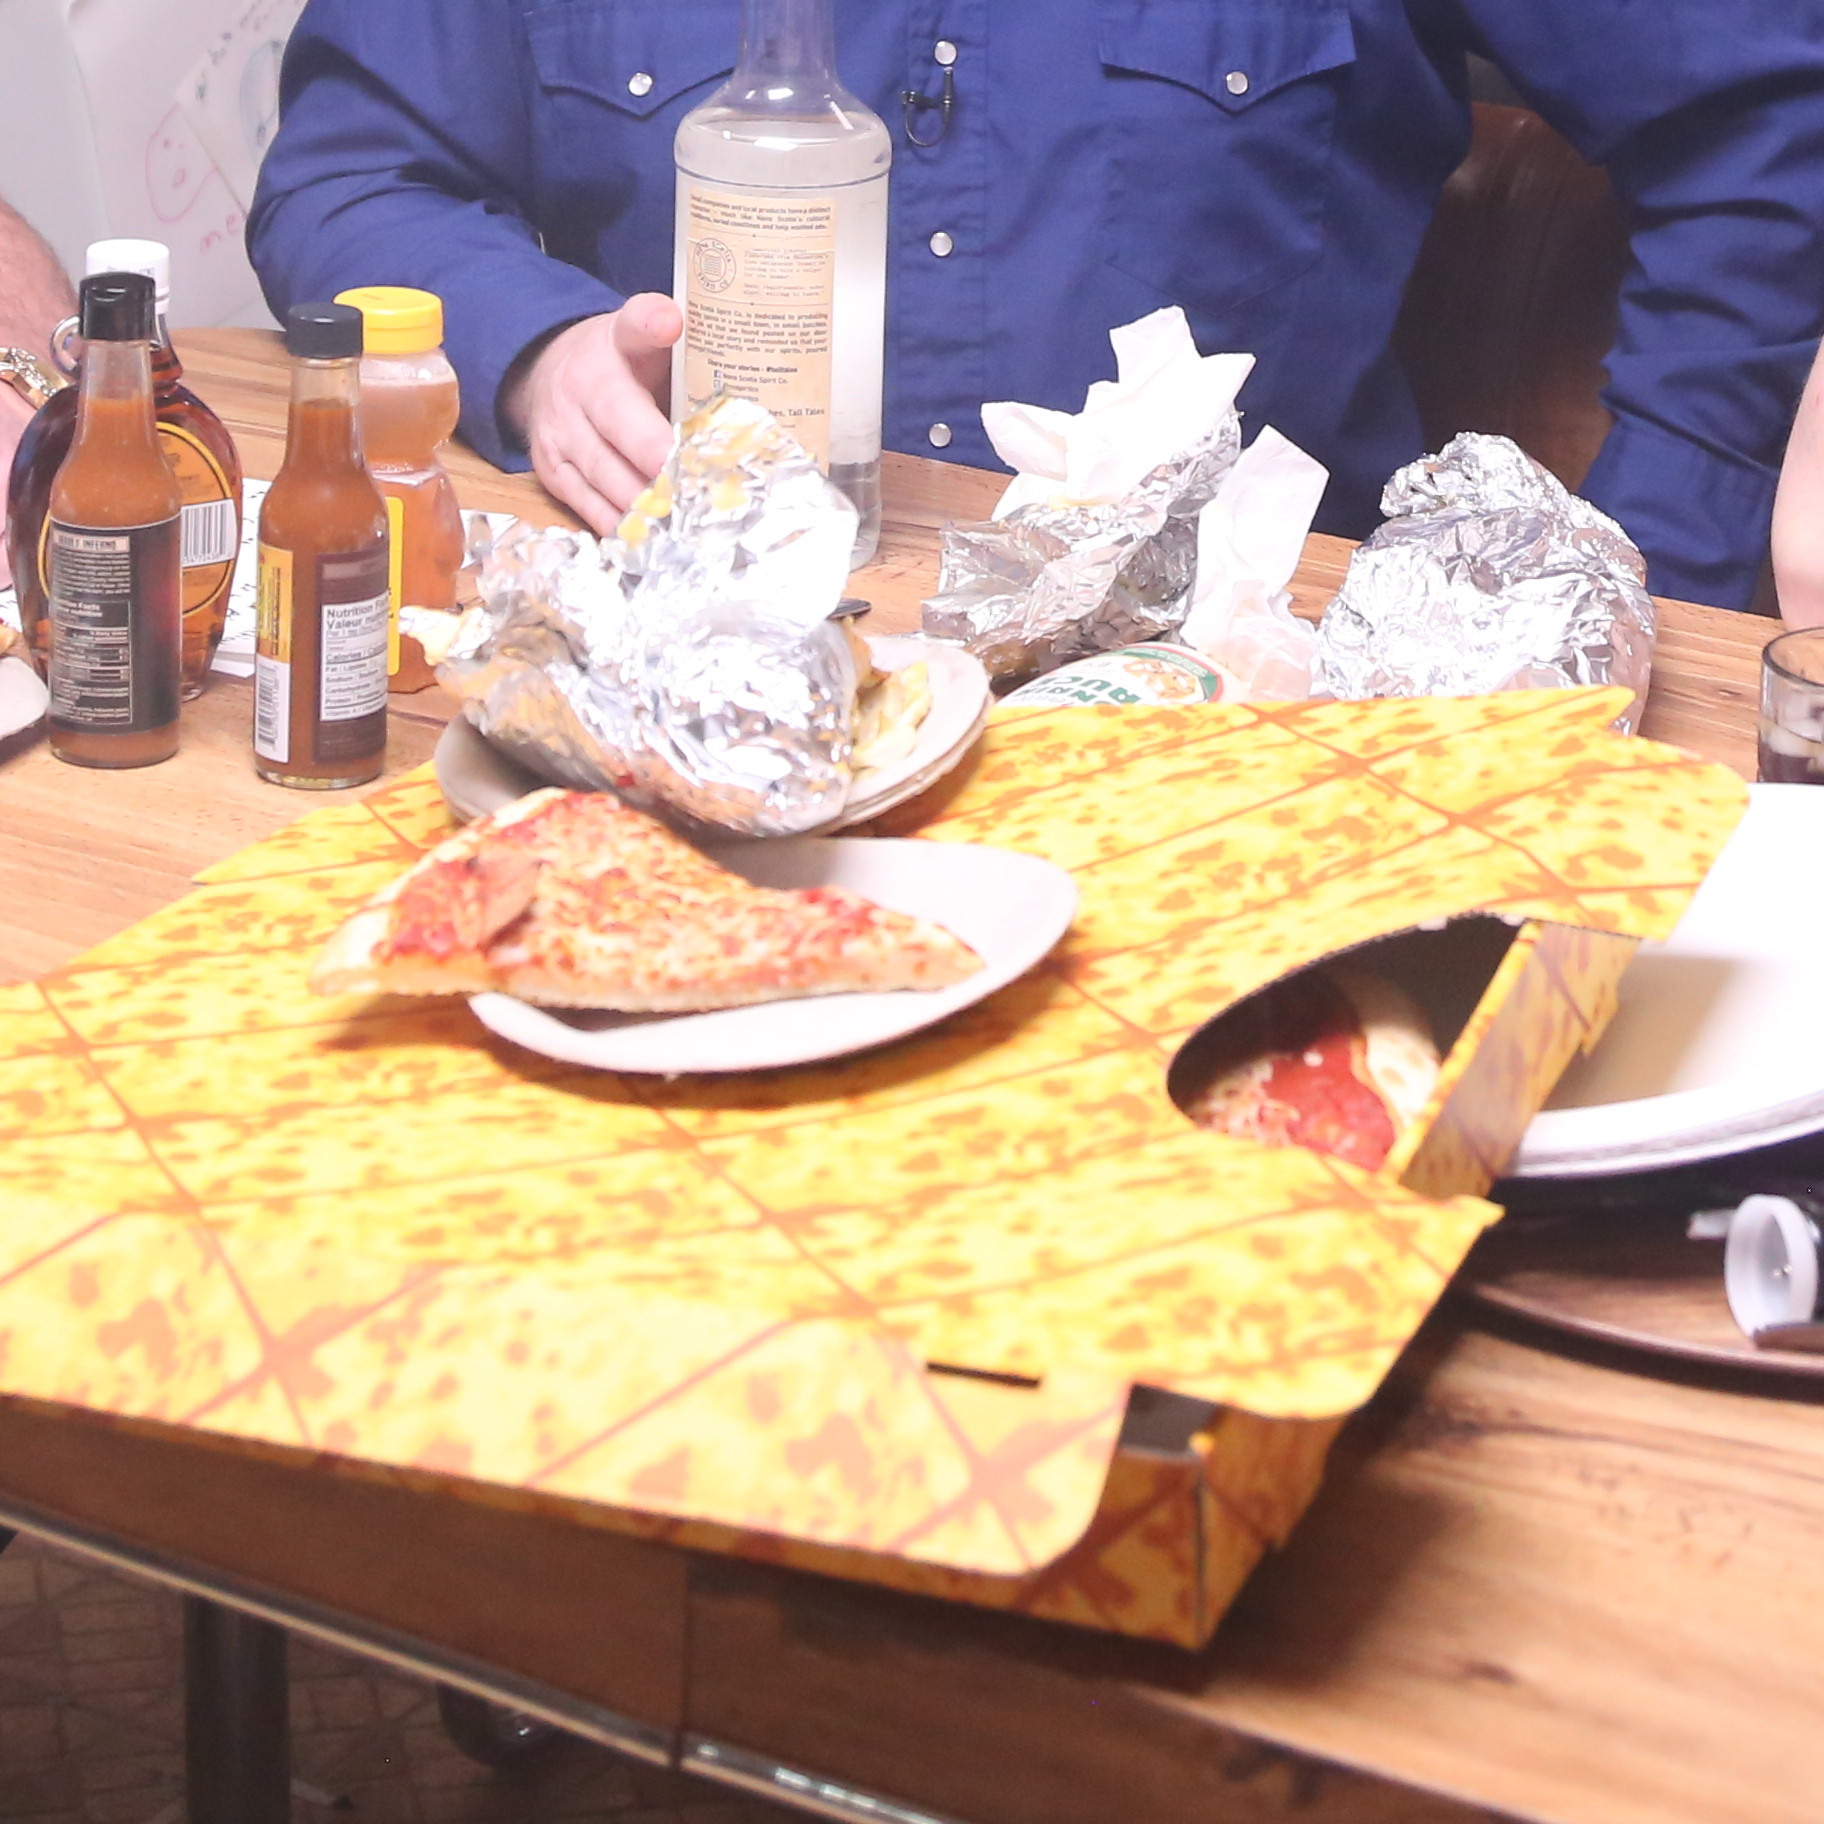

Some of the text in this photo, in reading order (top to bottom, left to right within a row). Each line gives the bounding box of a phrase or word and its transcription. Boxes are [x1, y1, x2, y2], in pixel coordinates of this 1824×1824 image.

[738, 375, 758, 383] Scotia
[788, 408, 803, 417] Tall
[805, 407, 825, 417] Tales
[326, 604, 373, 619] Nutrition
[326, 616, 362, 630] Valeur
[326, 651, 362, 663] Calories
